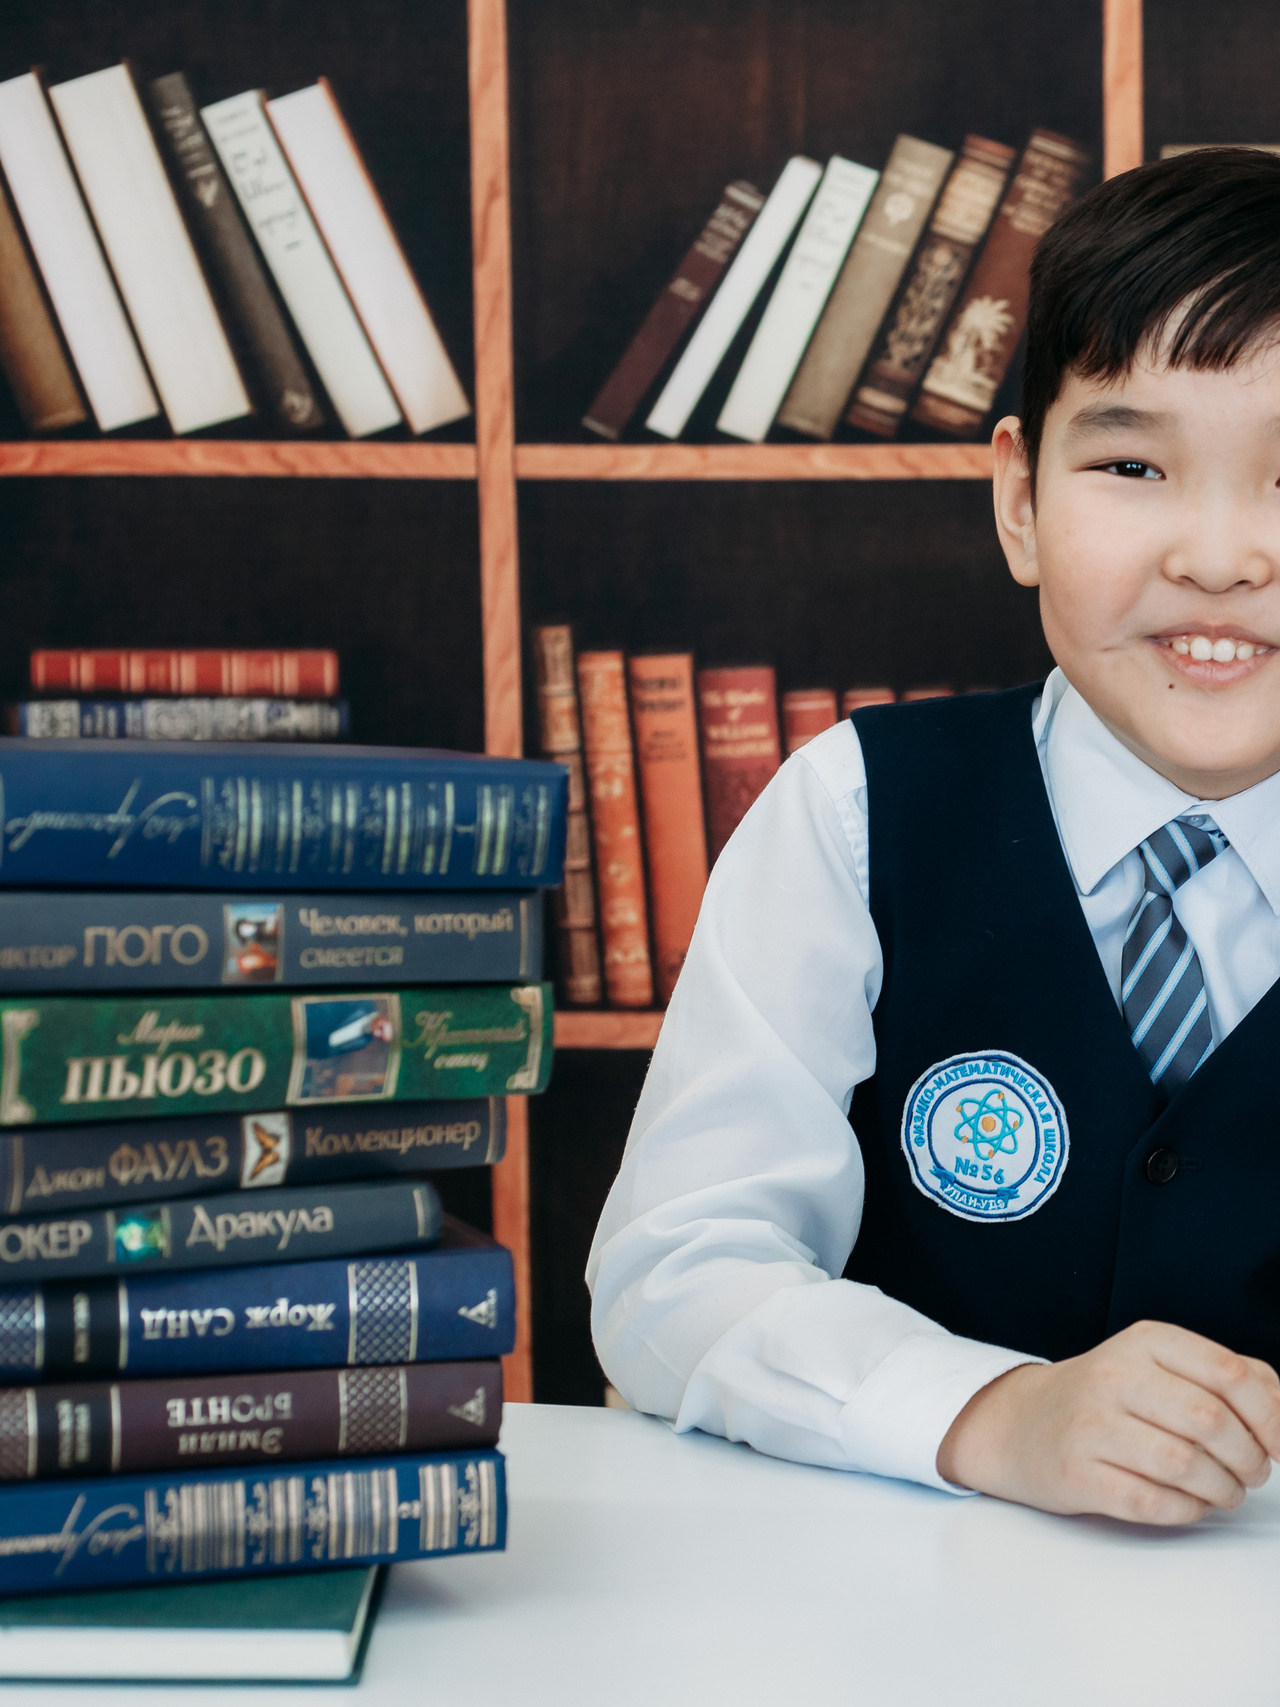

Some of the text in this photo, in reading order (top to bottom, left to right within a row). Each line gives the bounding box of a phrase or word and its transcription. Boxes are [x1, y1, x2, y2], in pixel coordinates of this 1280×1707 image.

[298, 907, 514, 940] Человек, который
[299, 945, 405, 969] смеется
[116, 1010, 204, 1056] Марио
[60, 1048, 267, 1104] ПЬЮЗО
[304, 1120, 482, 1158] Коллекционер
[913, 1062, 1057, 1184] ФИЗИКО-МАТЕМАТИЧЕСКАЯ ШКОЛА
[25, 1135, 230, 1199] Джон ФАУЛЗ
[944, 1185, 1006, 1212] УЛАН-УДЭ
[140, 1297, 336, 1341] Жорж САНД
[166, 1391, 292, 1428] БРОНТЕ
[178, 1427, 284, 1455] Эмили
